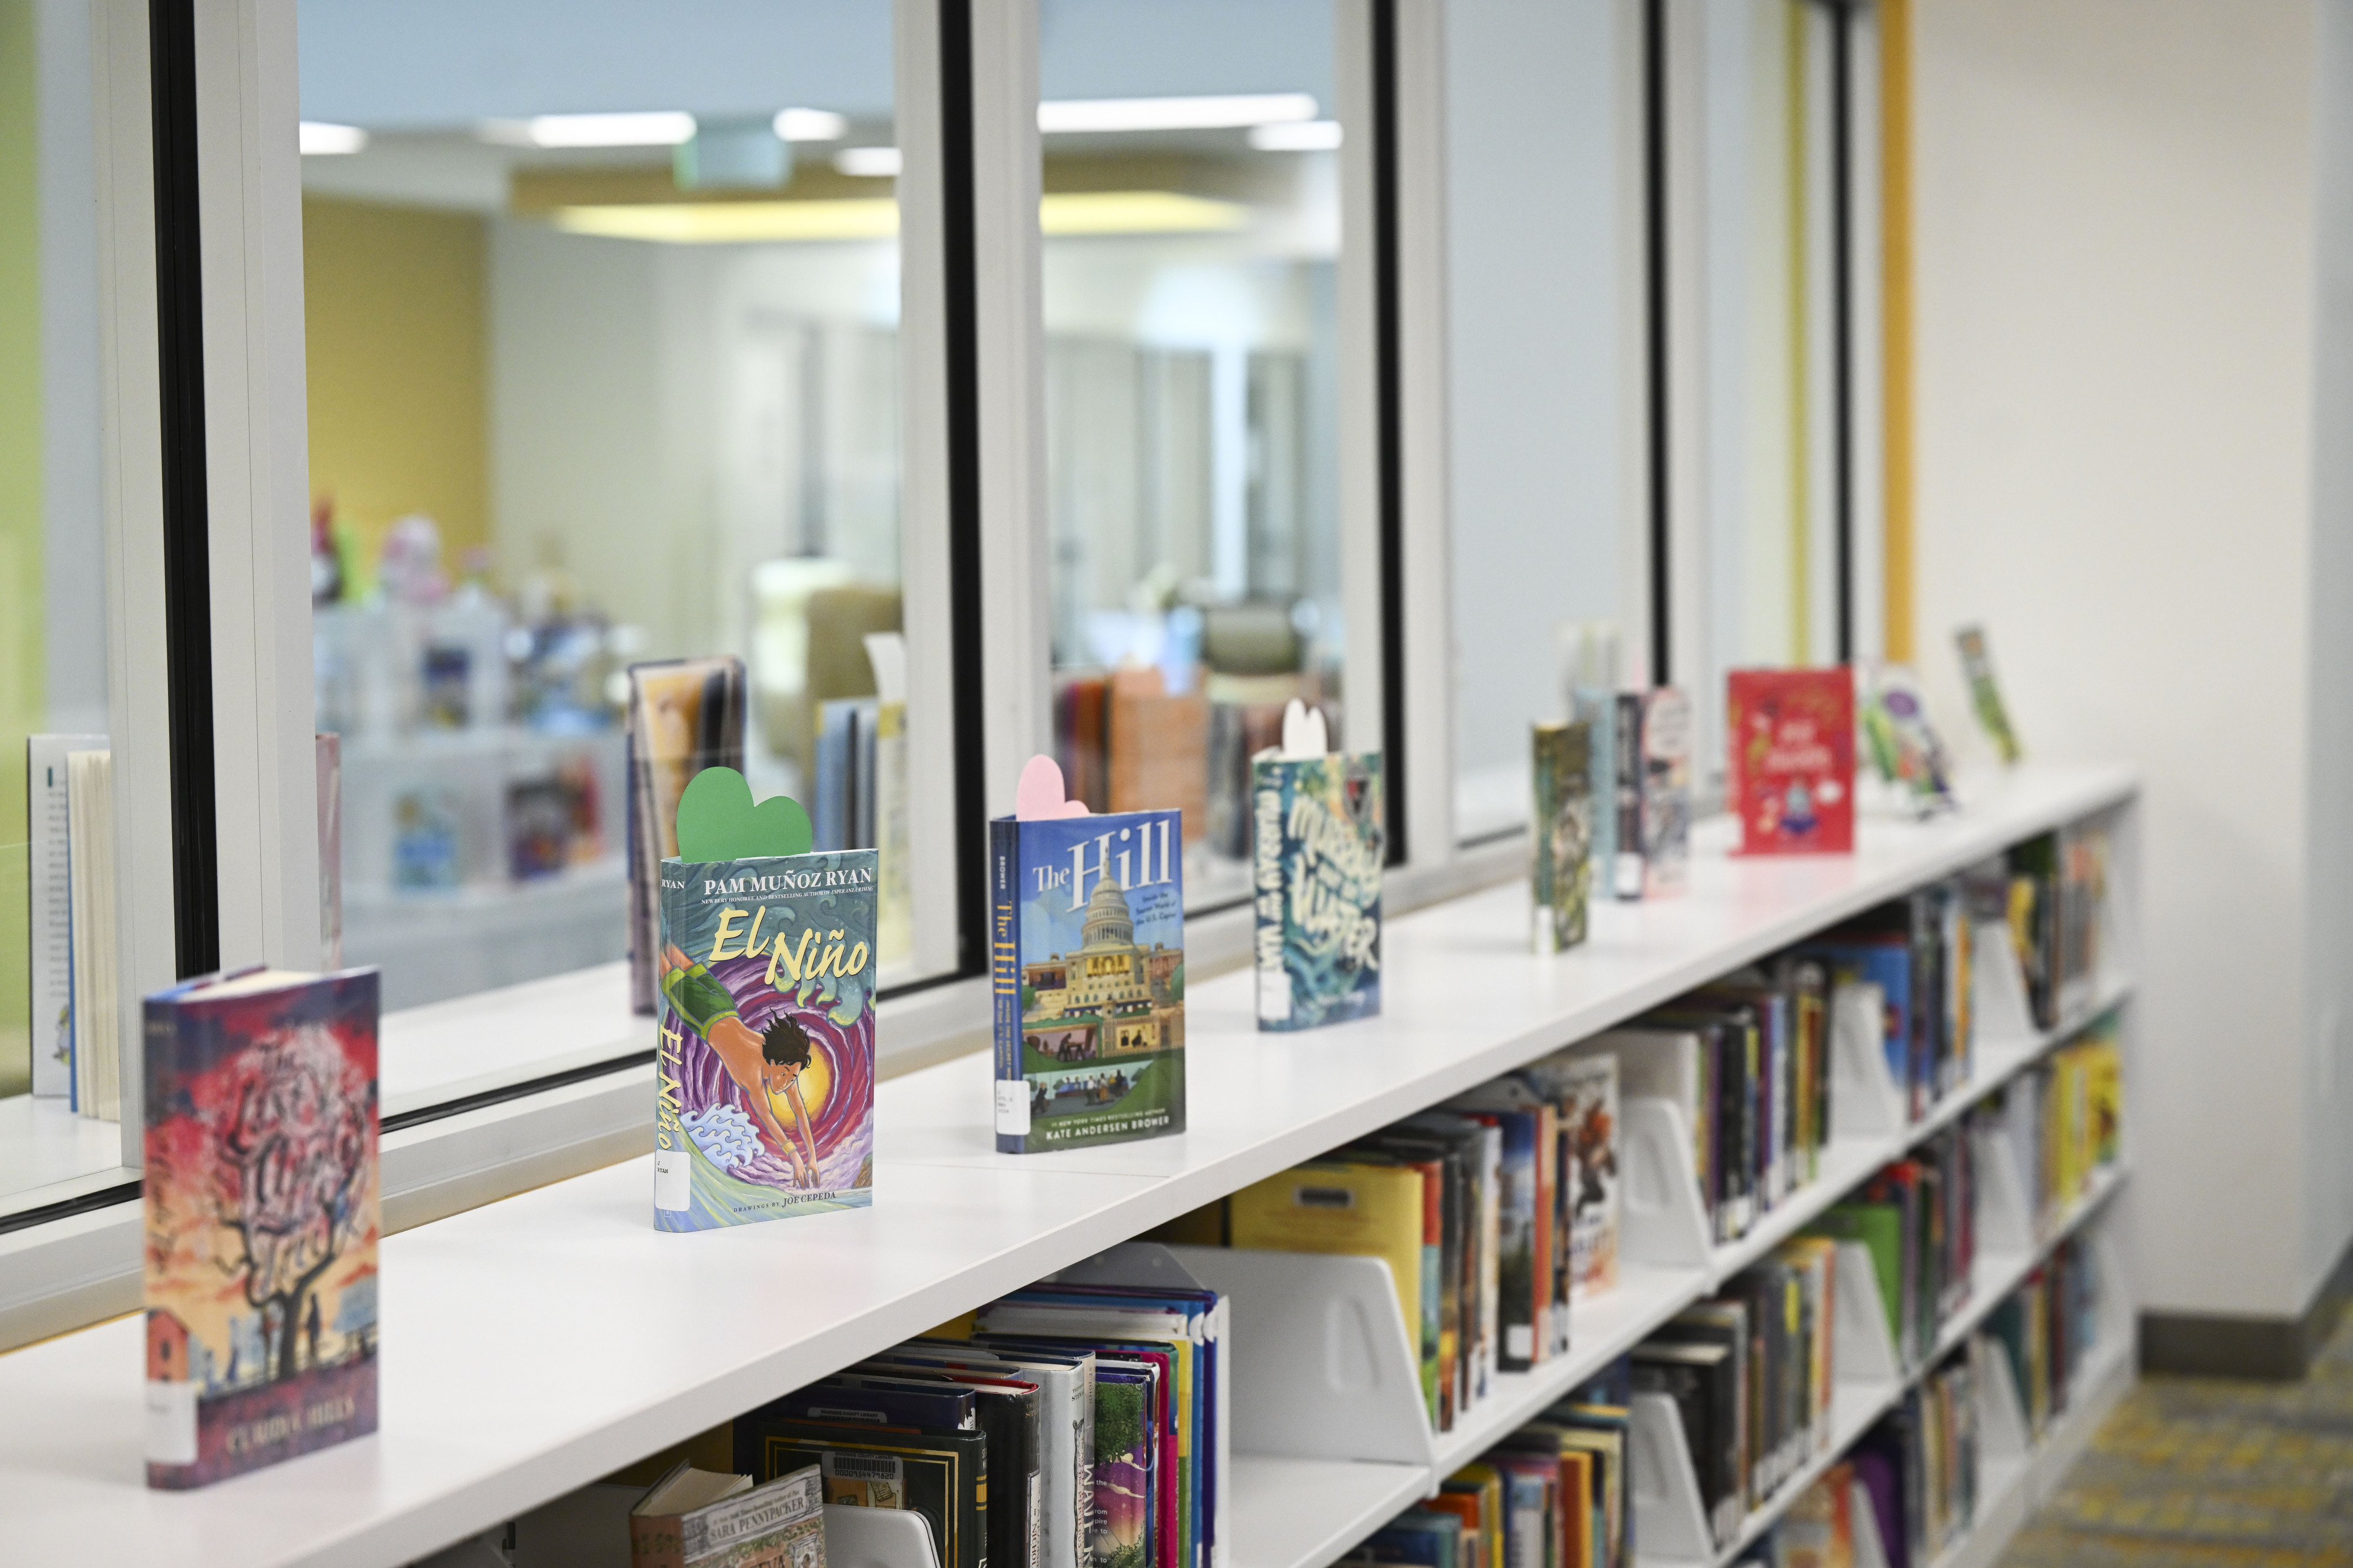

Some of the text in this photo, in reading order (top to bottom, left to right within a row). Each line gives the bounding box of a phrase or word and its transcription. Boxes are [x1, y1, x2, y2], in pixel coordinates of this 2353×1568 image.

[661, 879, 685, 889] RYAN
[704, 868, 874, 896] PAM MUÑOZ RYAN
[1033, 819, 1173, 913] The Hill
[708, 905, 770, 962] El
[764, 928, 868, 986] Niño
[994, 900, 1016, 995] The Hill
[657, 1024, 684, 1150] El Niño
[1046, 1129, 1071, 1140] KATE
[1075, 1122, 1128, 1137] ANDERSEN
[734, 1203, 769, 1213] DRAWINGS
[782, 1196, 799, 1207] JOE
[801, 1192, 836, 1203] CEPEDA
